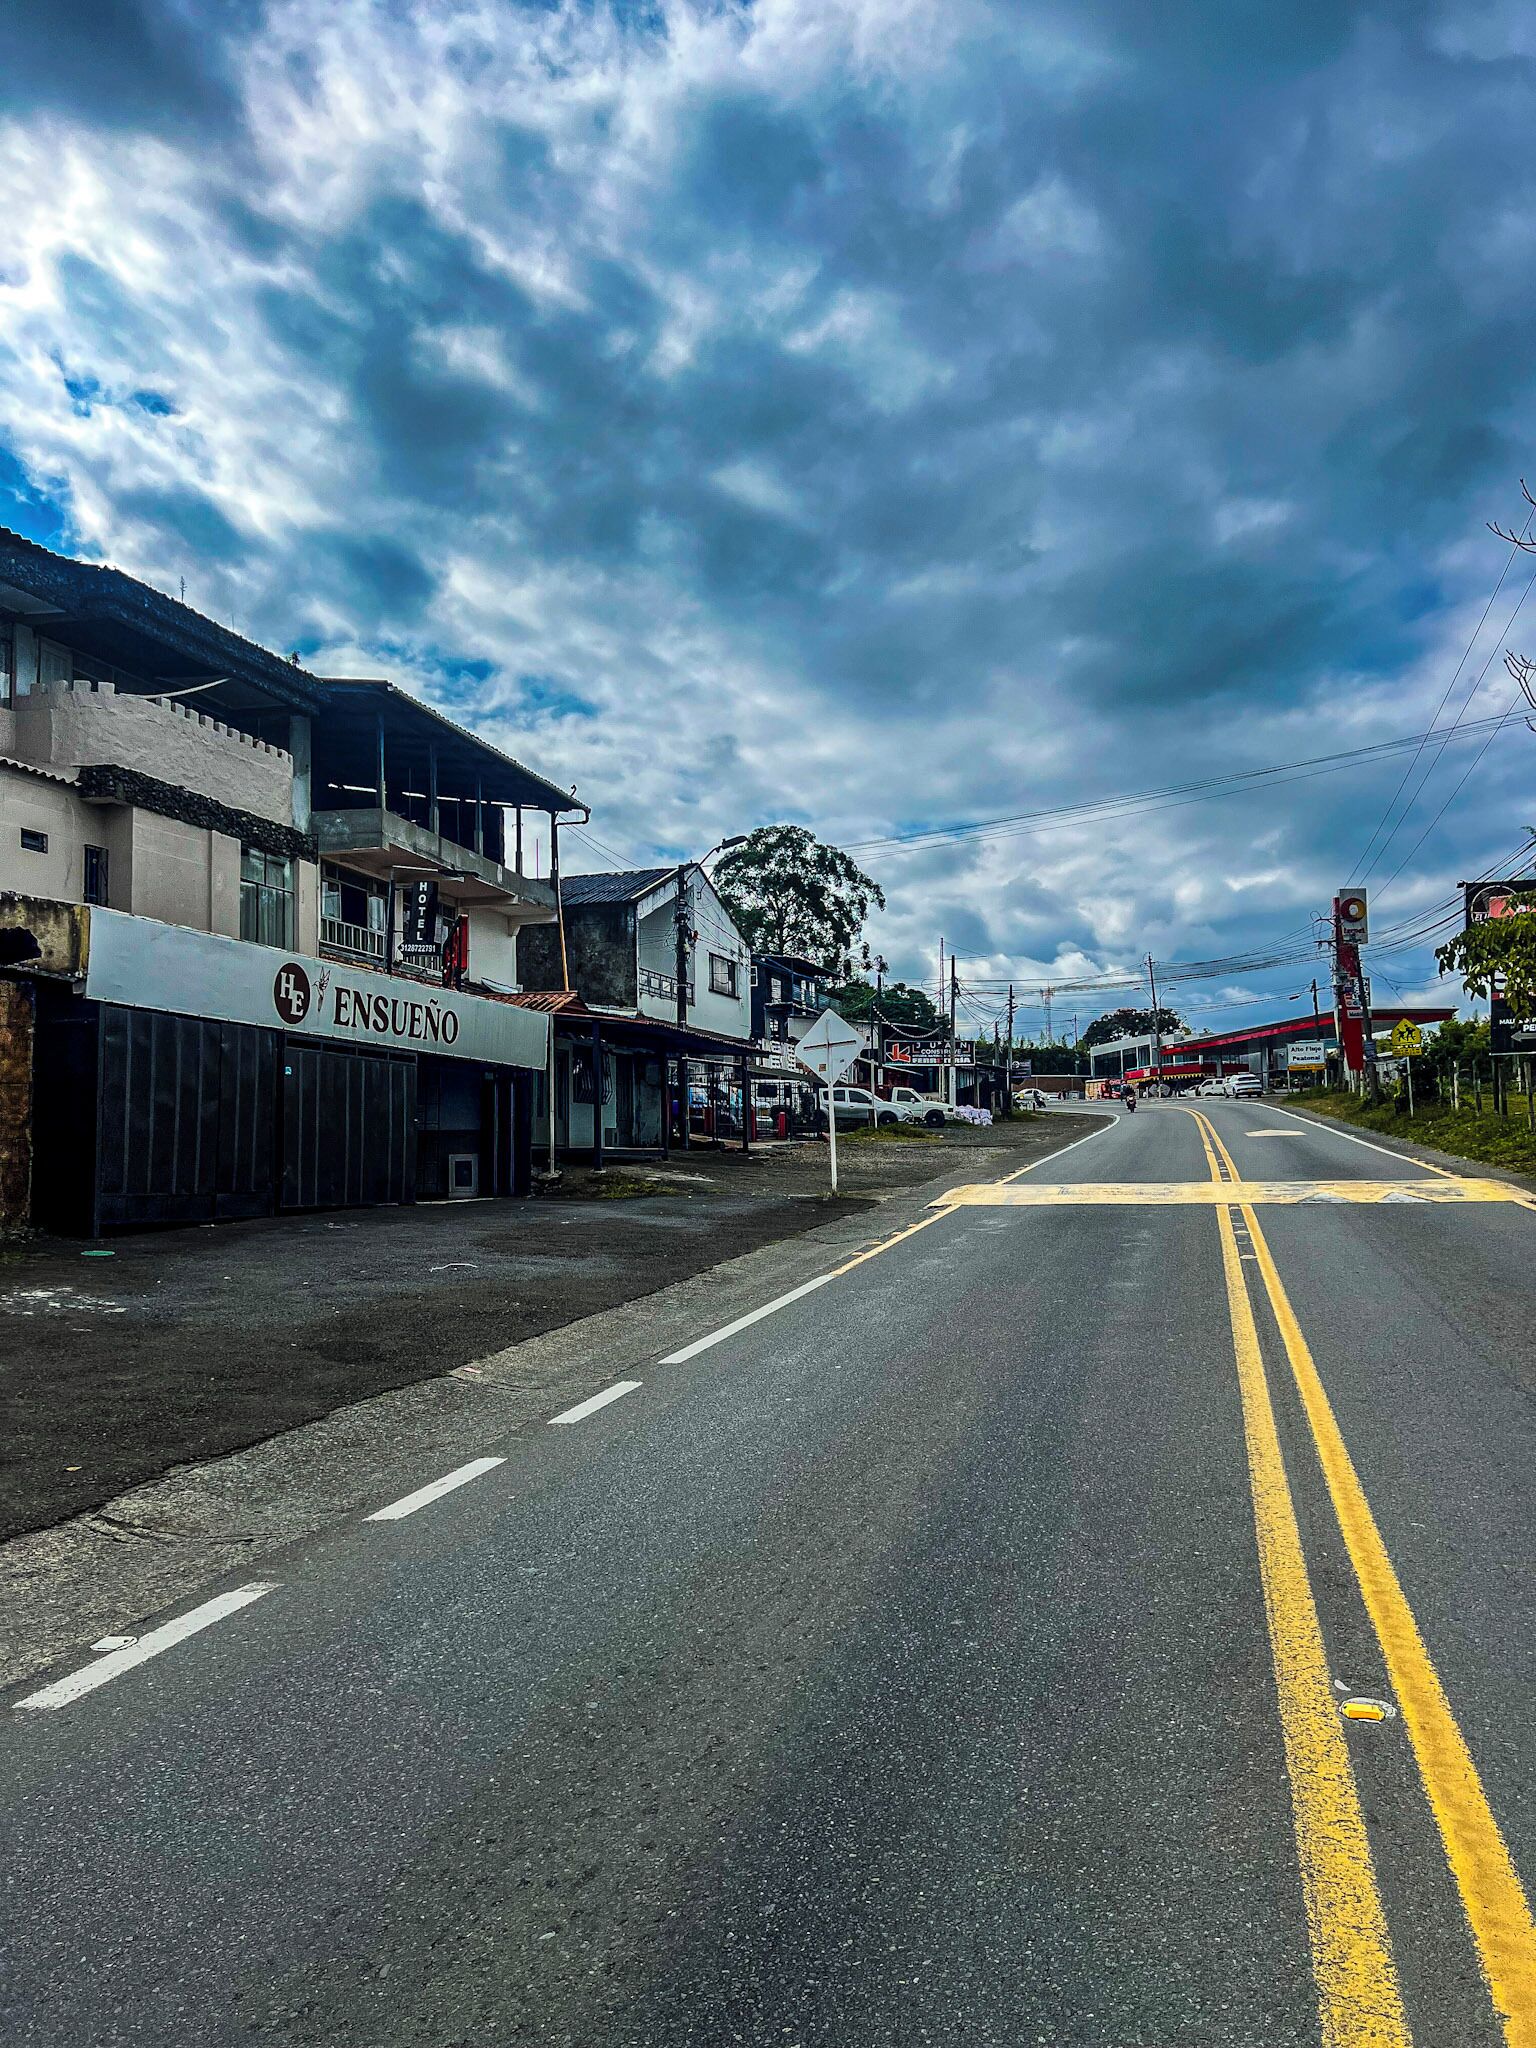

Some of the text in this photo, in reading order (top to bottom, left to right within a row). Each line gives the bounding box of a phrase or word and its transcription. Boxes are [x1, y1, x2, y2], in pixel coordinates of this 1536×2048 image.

[416, 881, 428, 941] HOTEL
[400, 944, 436, 953] 3128722791
[333, 986, 459, 1045] ENSUEÑO
